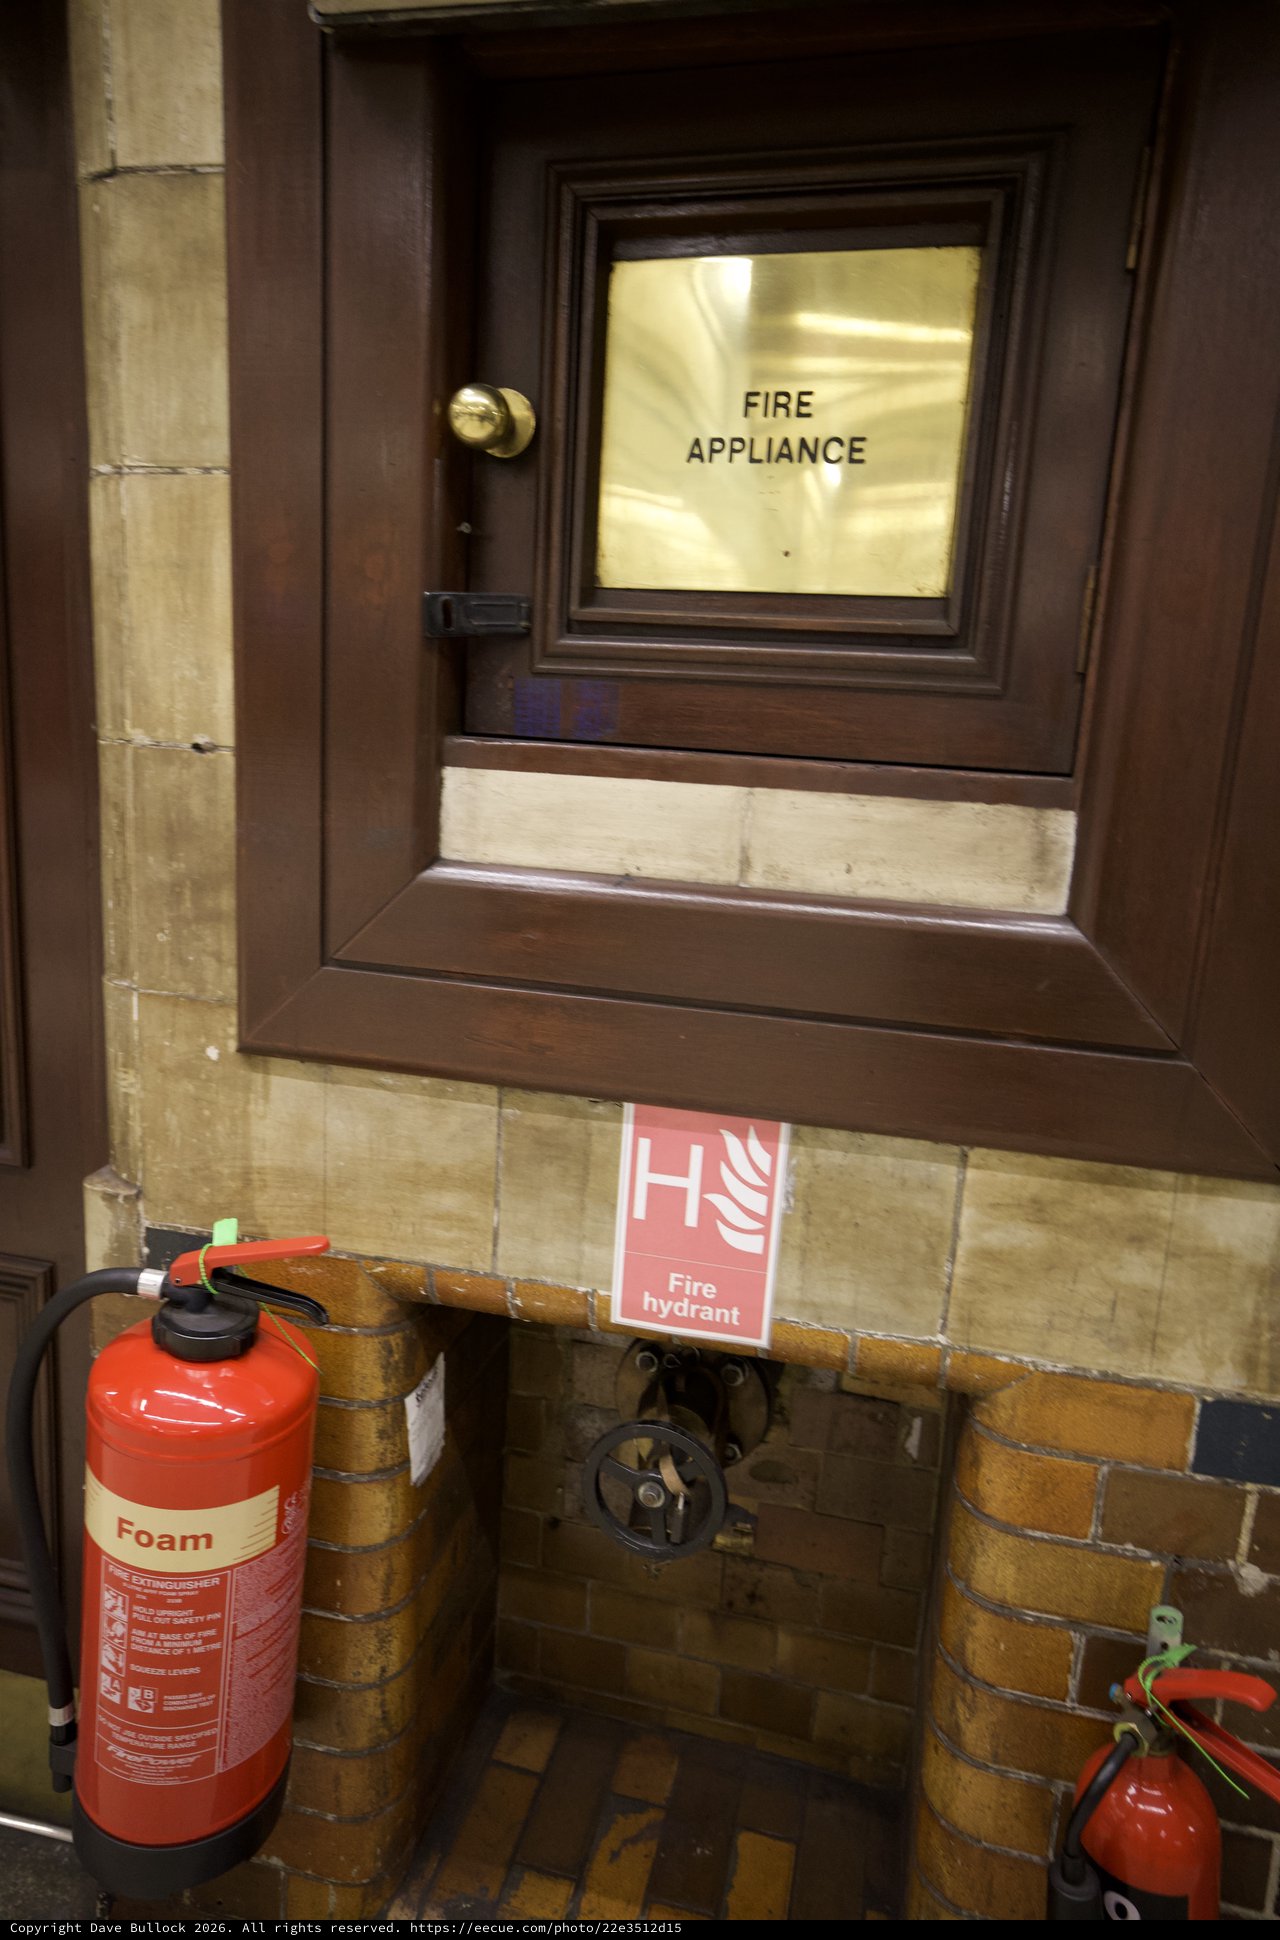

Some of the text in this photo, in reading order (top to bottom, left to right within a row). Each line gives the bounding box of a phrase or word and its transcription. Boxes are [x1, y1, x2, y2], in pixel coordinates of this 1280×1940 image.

[743, 390, 815, 419] FIRE
[686, 436, 868, 465] APPLIANCE
[632, 1136, 704, 1228] H
[668, 1272, 718, 1299] Fire
[642, 1290, 741, 1326] hydrant
[116, 1516, 214, 1552] Foam
[108, 1564, 130, 1581] FIRE
[131, 1575, 220, 1590] EXTINGUISHER
[132, 1604, 195, 1617] HOLD UPRIGHT
[132, 1612, 222, 1625] PULL OUT SAFETY PIN
[130, 1635, 155, 1646] FROM
[163, 1639, 203, 1648] MINIMUM
[131, 1628, 146, 1637] AIM
[183, 1631, 196, 1639] OF
[197, 1628, 217, 1637] FIRE
[130, 1643, 171, 1655] DISTANCE
[192, 1642, 222, 1654] METRE
[129, 1663, 201, 1676] SQUEEZE LEVERS
[112, 1679, 121, 1690] A
[143, 1689, 154, 1700] B
[111, 1731, 197, 1750] TEMPERATURE RANGE
[138, 1733, 173, 1742] OUTSIDE
